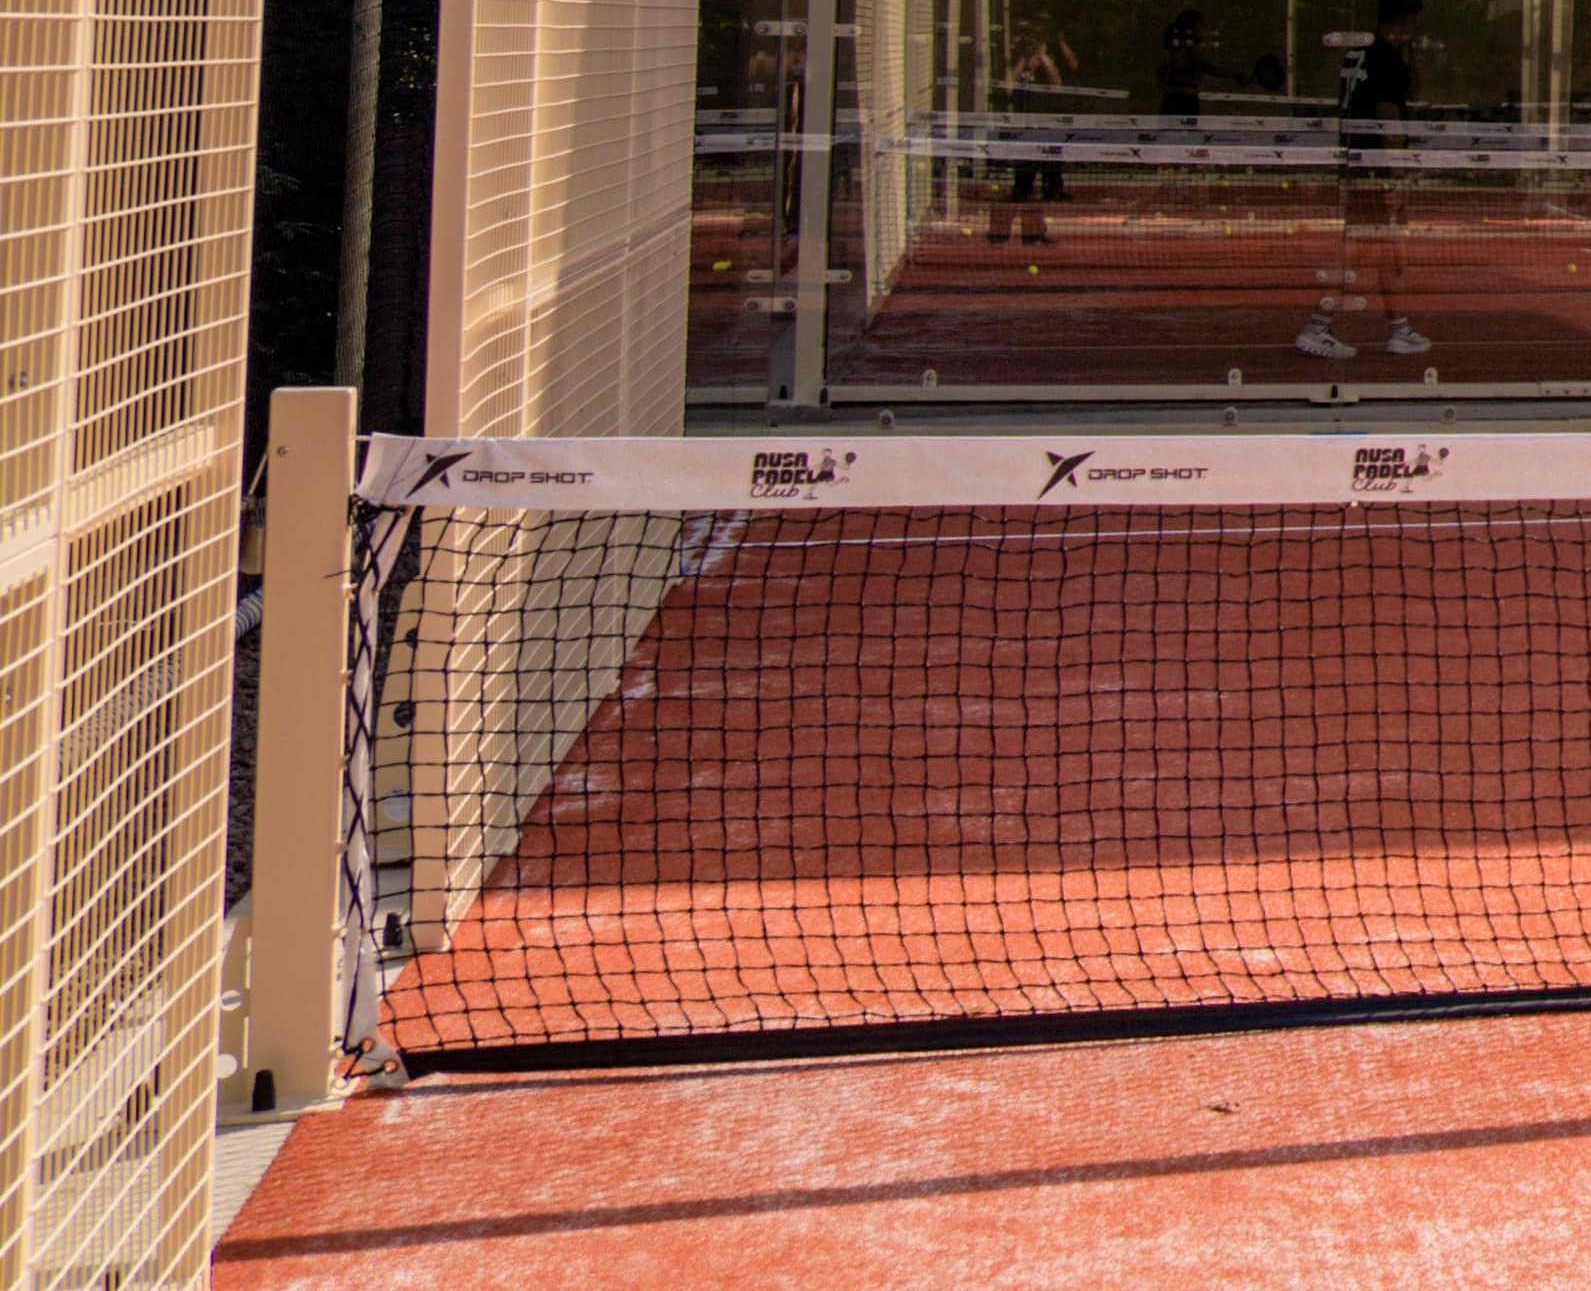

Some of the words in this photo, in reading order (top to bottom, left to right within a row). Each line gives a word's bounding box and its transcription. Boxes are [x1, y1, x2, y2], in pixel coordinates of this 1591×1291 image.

[754, 452, 809, 468] NUSA
[1356, 448, 1405, 463] NUSA
[462, 470, 525, 483] DROP
[530, 472, 593, 484] SHOT
[752, 469, 818, 485] PADEL
[1088, 469, 1146, 480] DROP
[1150, 468, 1208, 479] SHOT
[1353, 464, 1413, 479] PADEL
[751, 483, 800, 498] Club
[1352, 478, 1397, 491] Club
